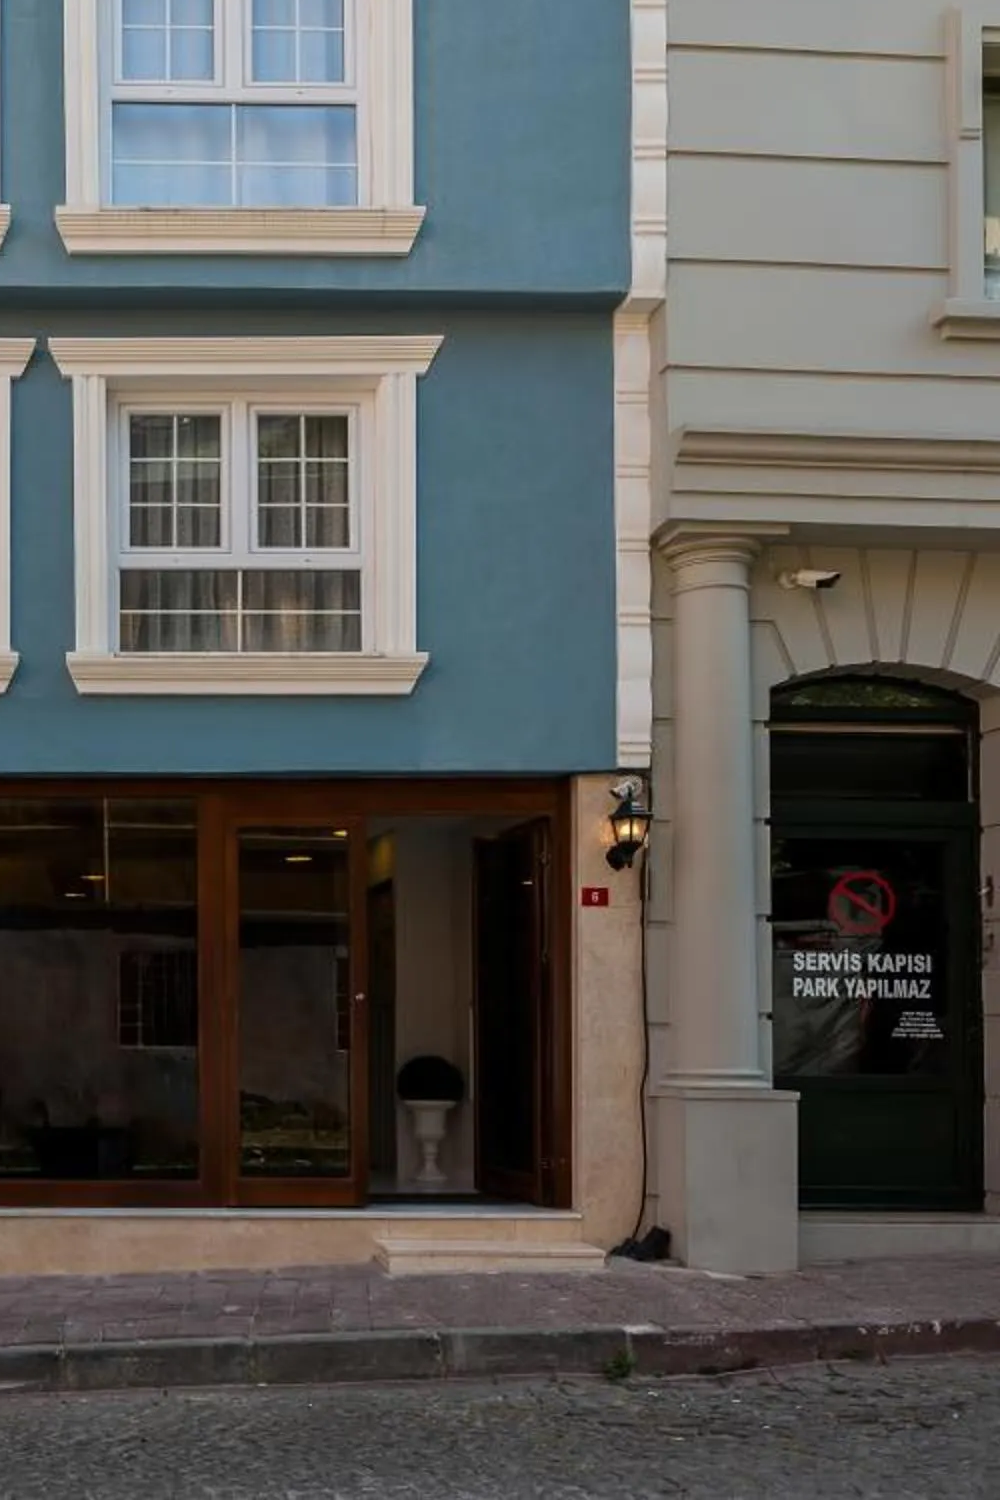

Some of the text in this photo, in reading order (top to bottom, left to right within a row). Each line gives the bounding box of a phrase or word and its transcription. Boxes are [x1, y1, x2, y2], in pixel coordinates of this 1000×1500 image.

[793, 948, 932, 974] SERVİS KAPISI
[793, 977, 931, 999] PARK YAPILMAZ
